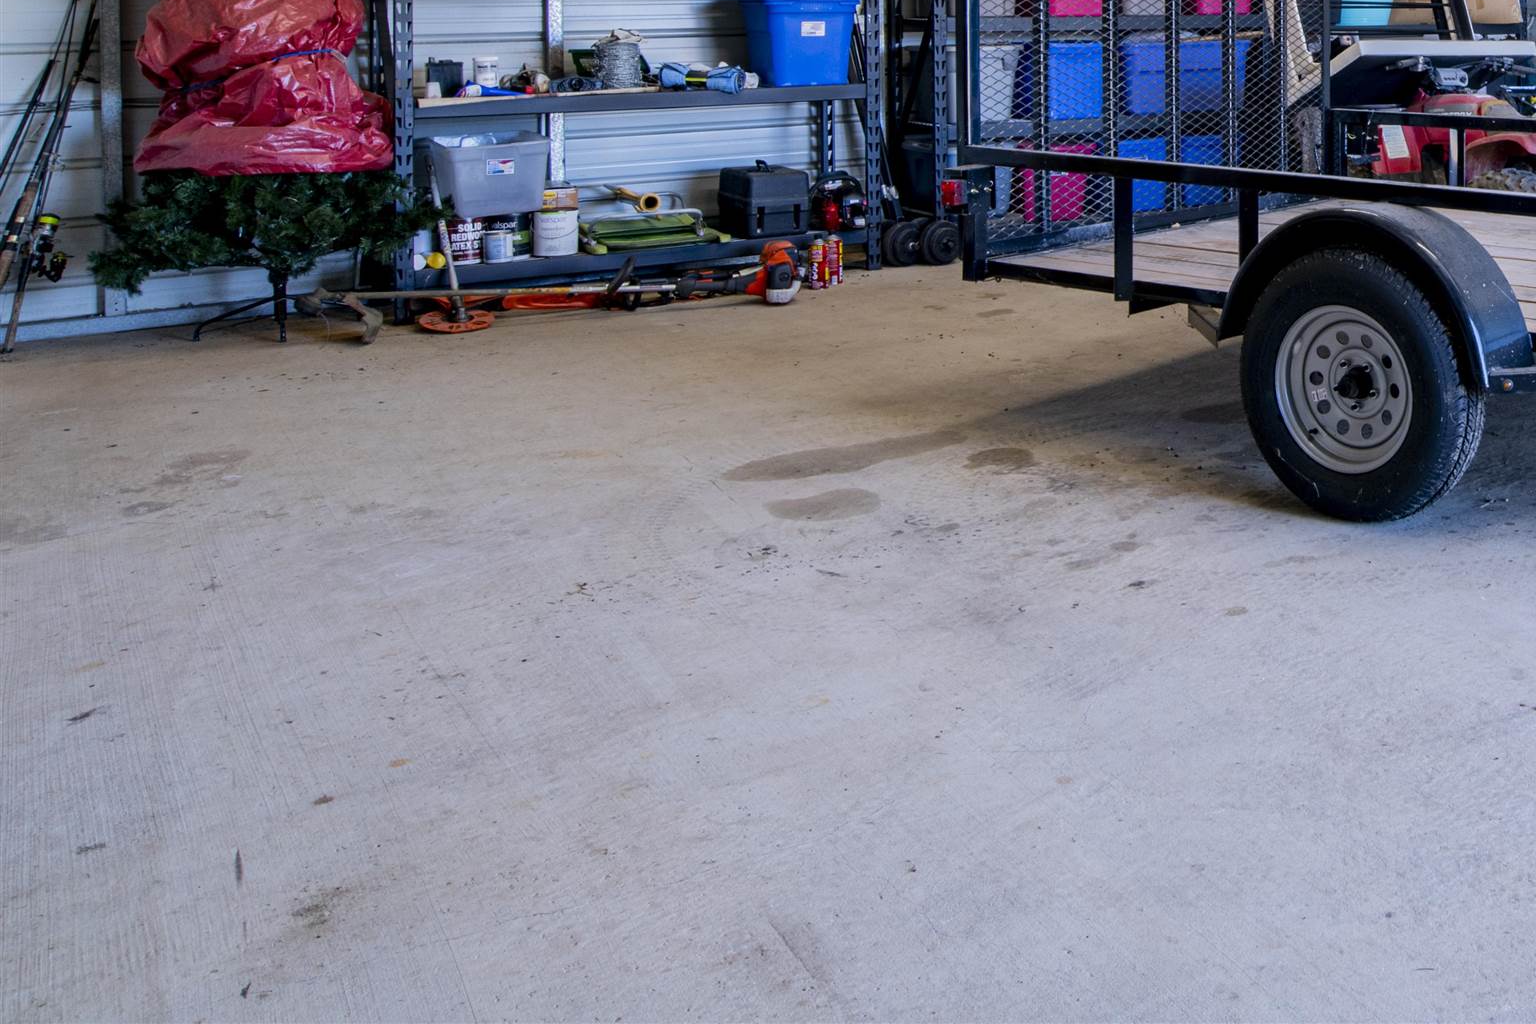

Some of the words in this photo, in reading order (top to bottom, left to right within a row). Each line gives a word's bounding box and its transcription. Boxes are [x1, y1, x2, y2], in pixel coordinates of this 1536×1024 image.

[458, 222, 482, 232] SOLID
[451, 231, 482, 242] REDWO
[450, 240, 471, 251] ATEX
